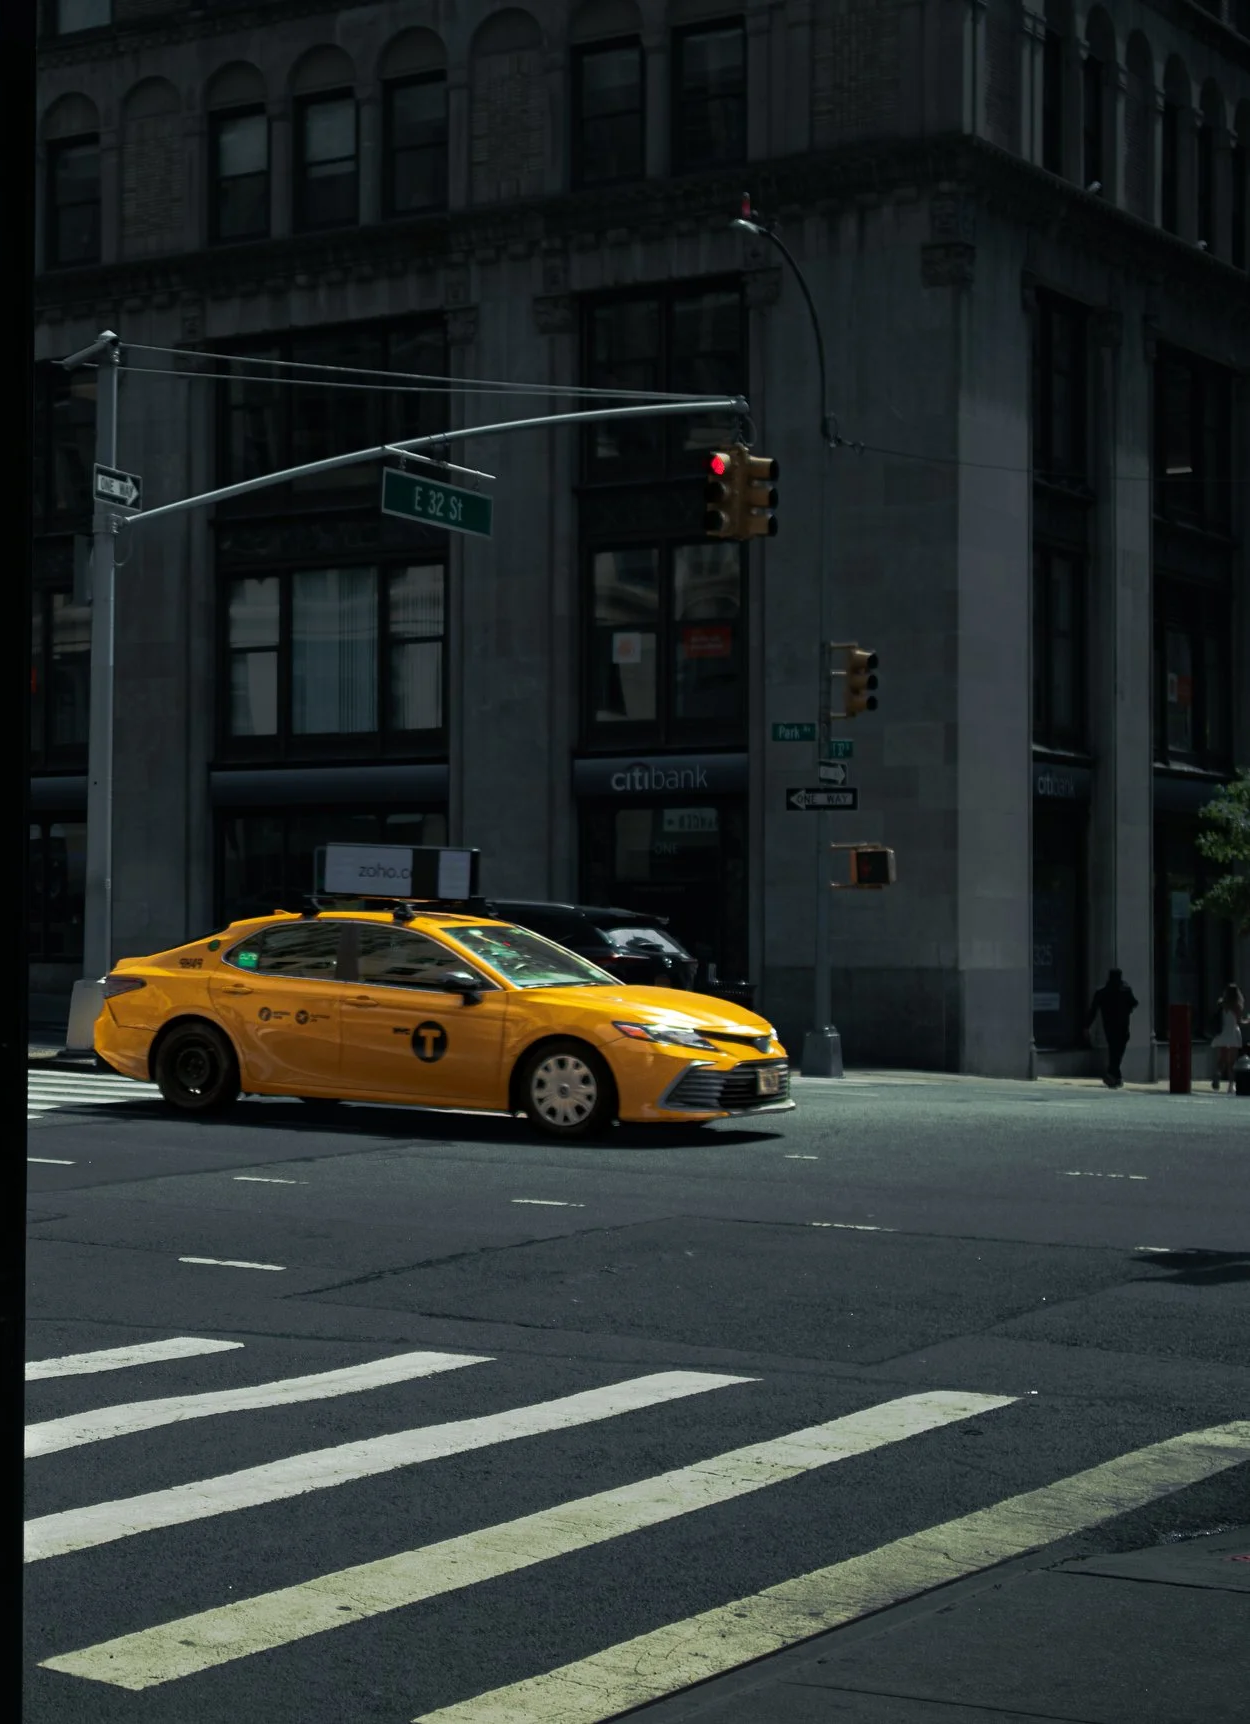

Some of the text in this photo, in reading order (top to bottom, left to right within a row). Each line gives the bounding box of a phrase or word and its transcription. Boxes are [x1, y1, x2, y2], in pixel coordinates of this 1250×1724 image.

[100, 476, 114, 493] ONE
[414, 486, 464, 521] E 32 St
[778, 725, 800, 739] Park
[610, 763, 708, 791] citibank
[797, 794, 848, 804] ONE WAY
[358, 862, 412, 879] zoho.c
